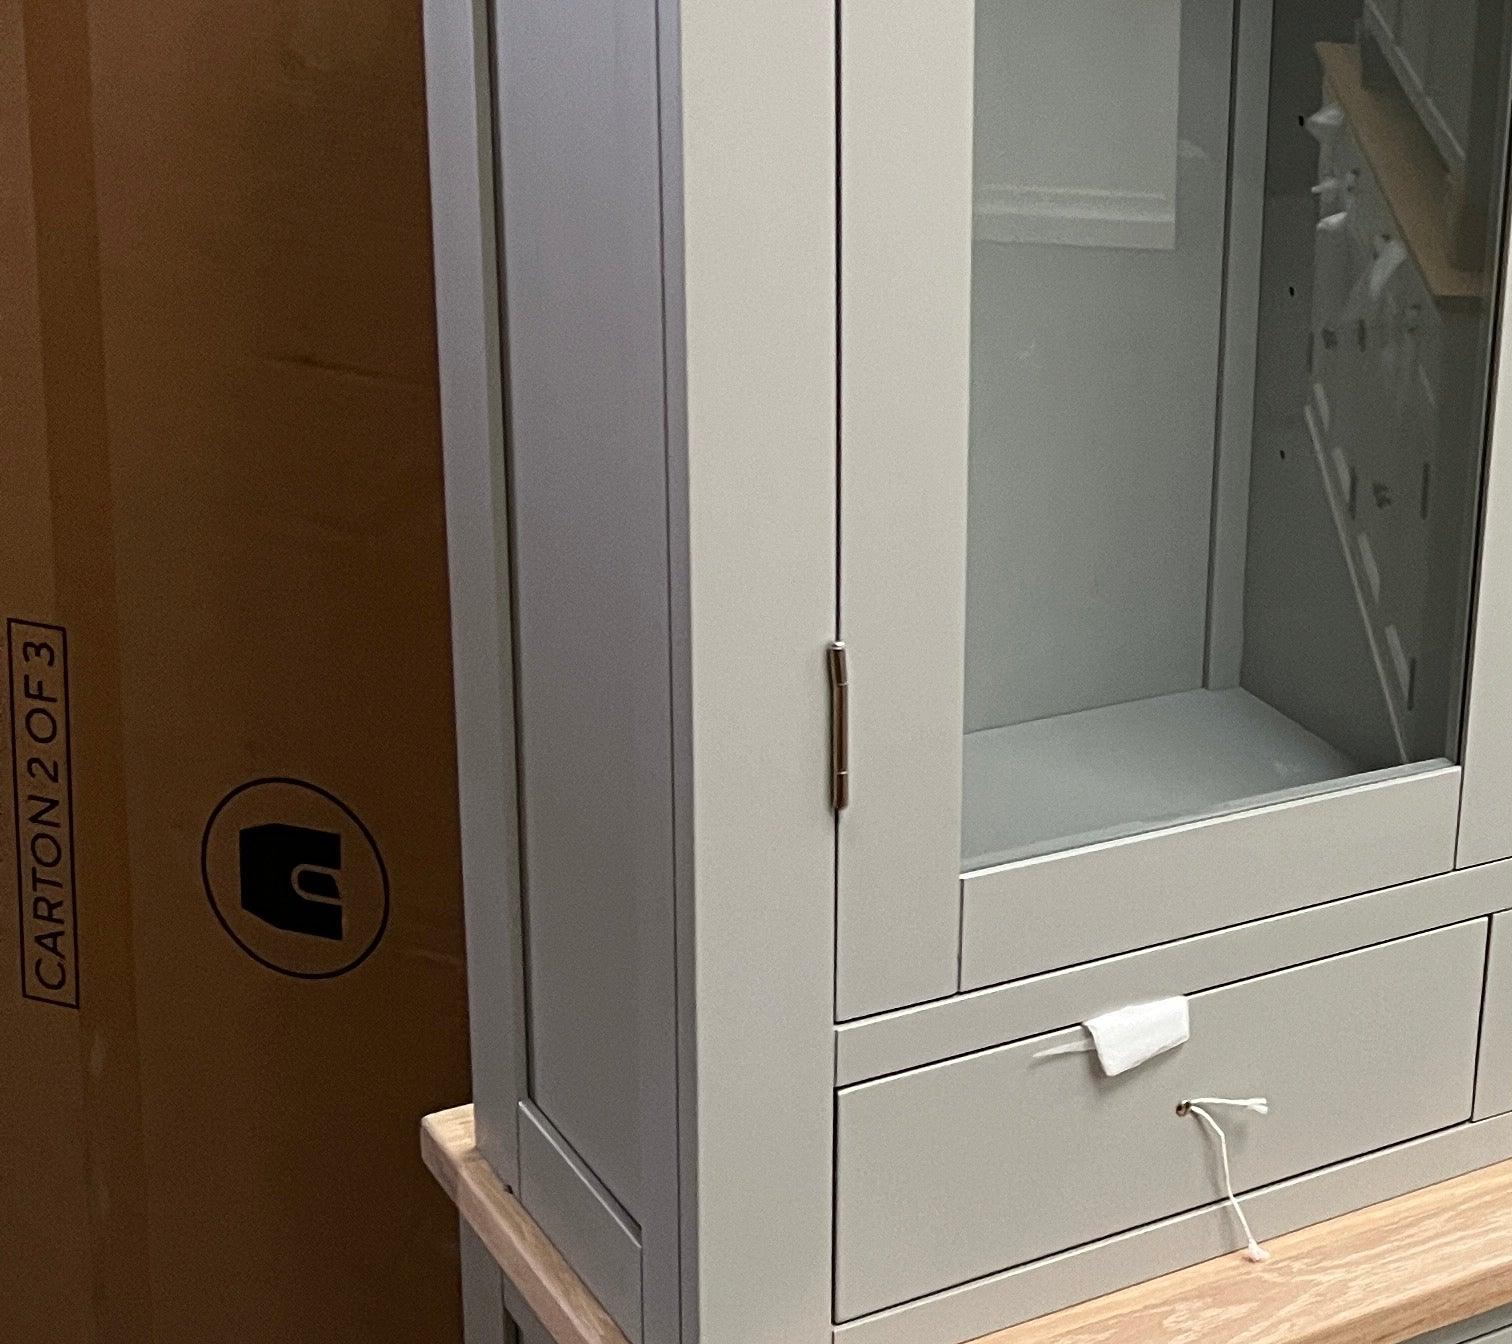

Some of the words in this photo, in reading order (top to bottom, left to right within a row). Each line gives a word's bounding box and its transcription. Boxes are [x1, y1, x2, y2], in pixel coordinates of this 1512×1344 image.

[22, 640, 56, 668] 3
[23, 673, 59, 745] OF
[26, 756, 60, 784] 2
[27, 793, 67, 991] CARTON
